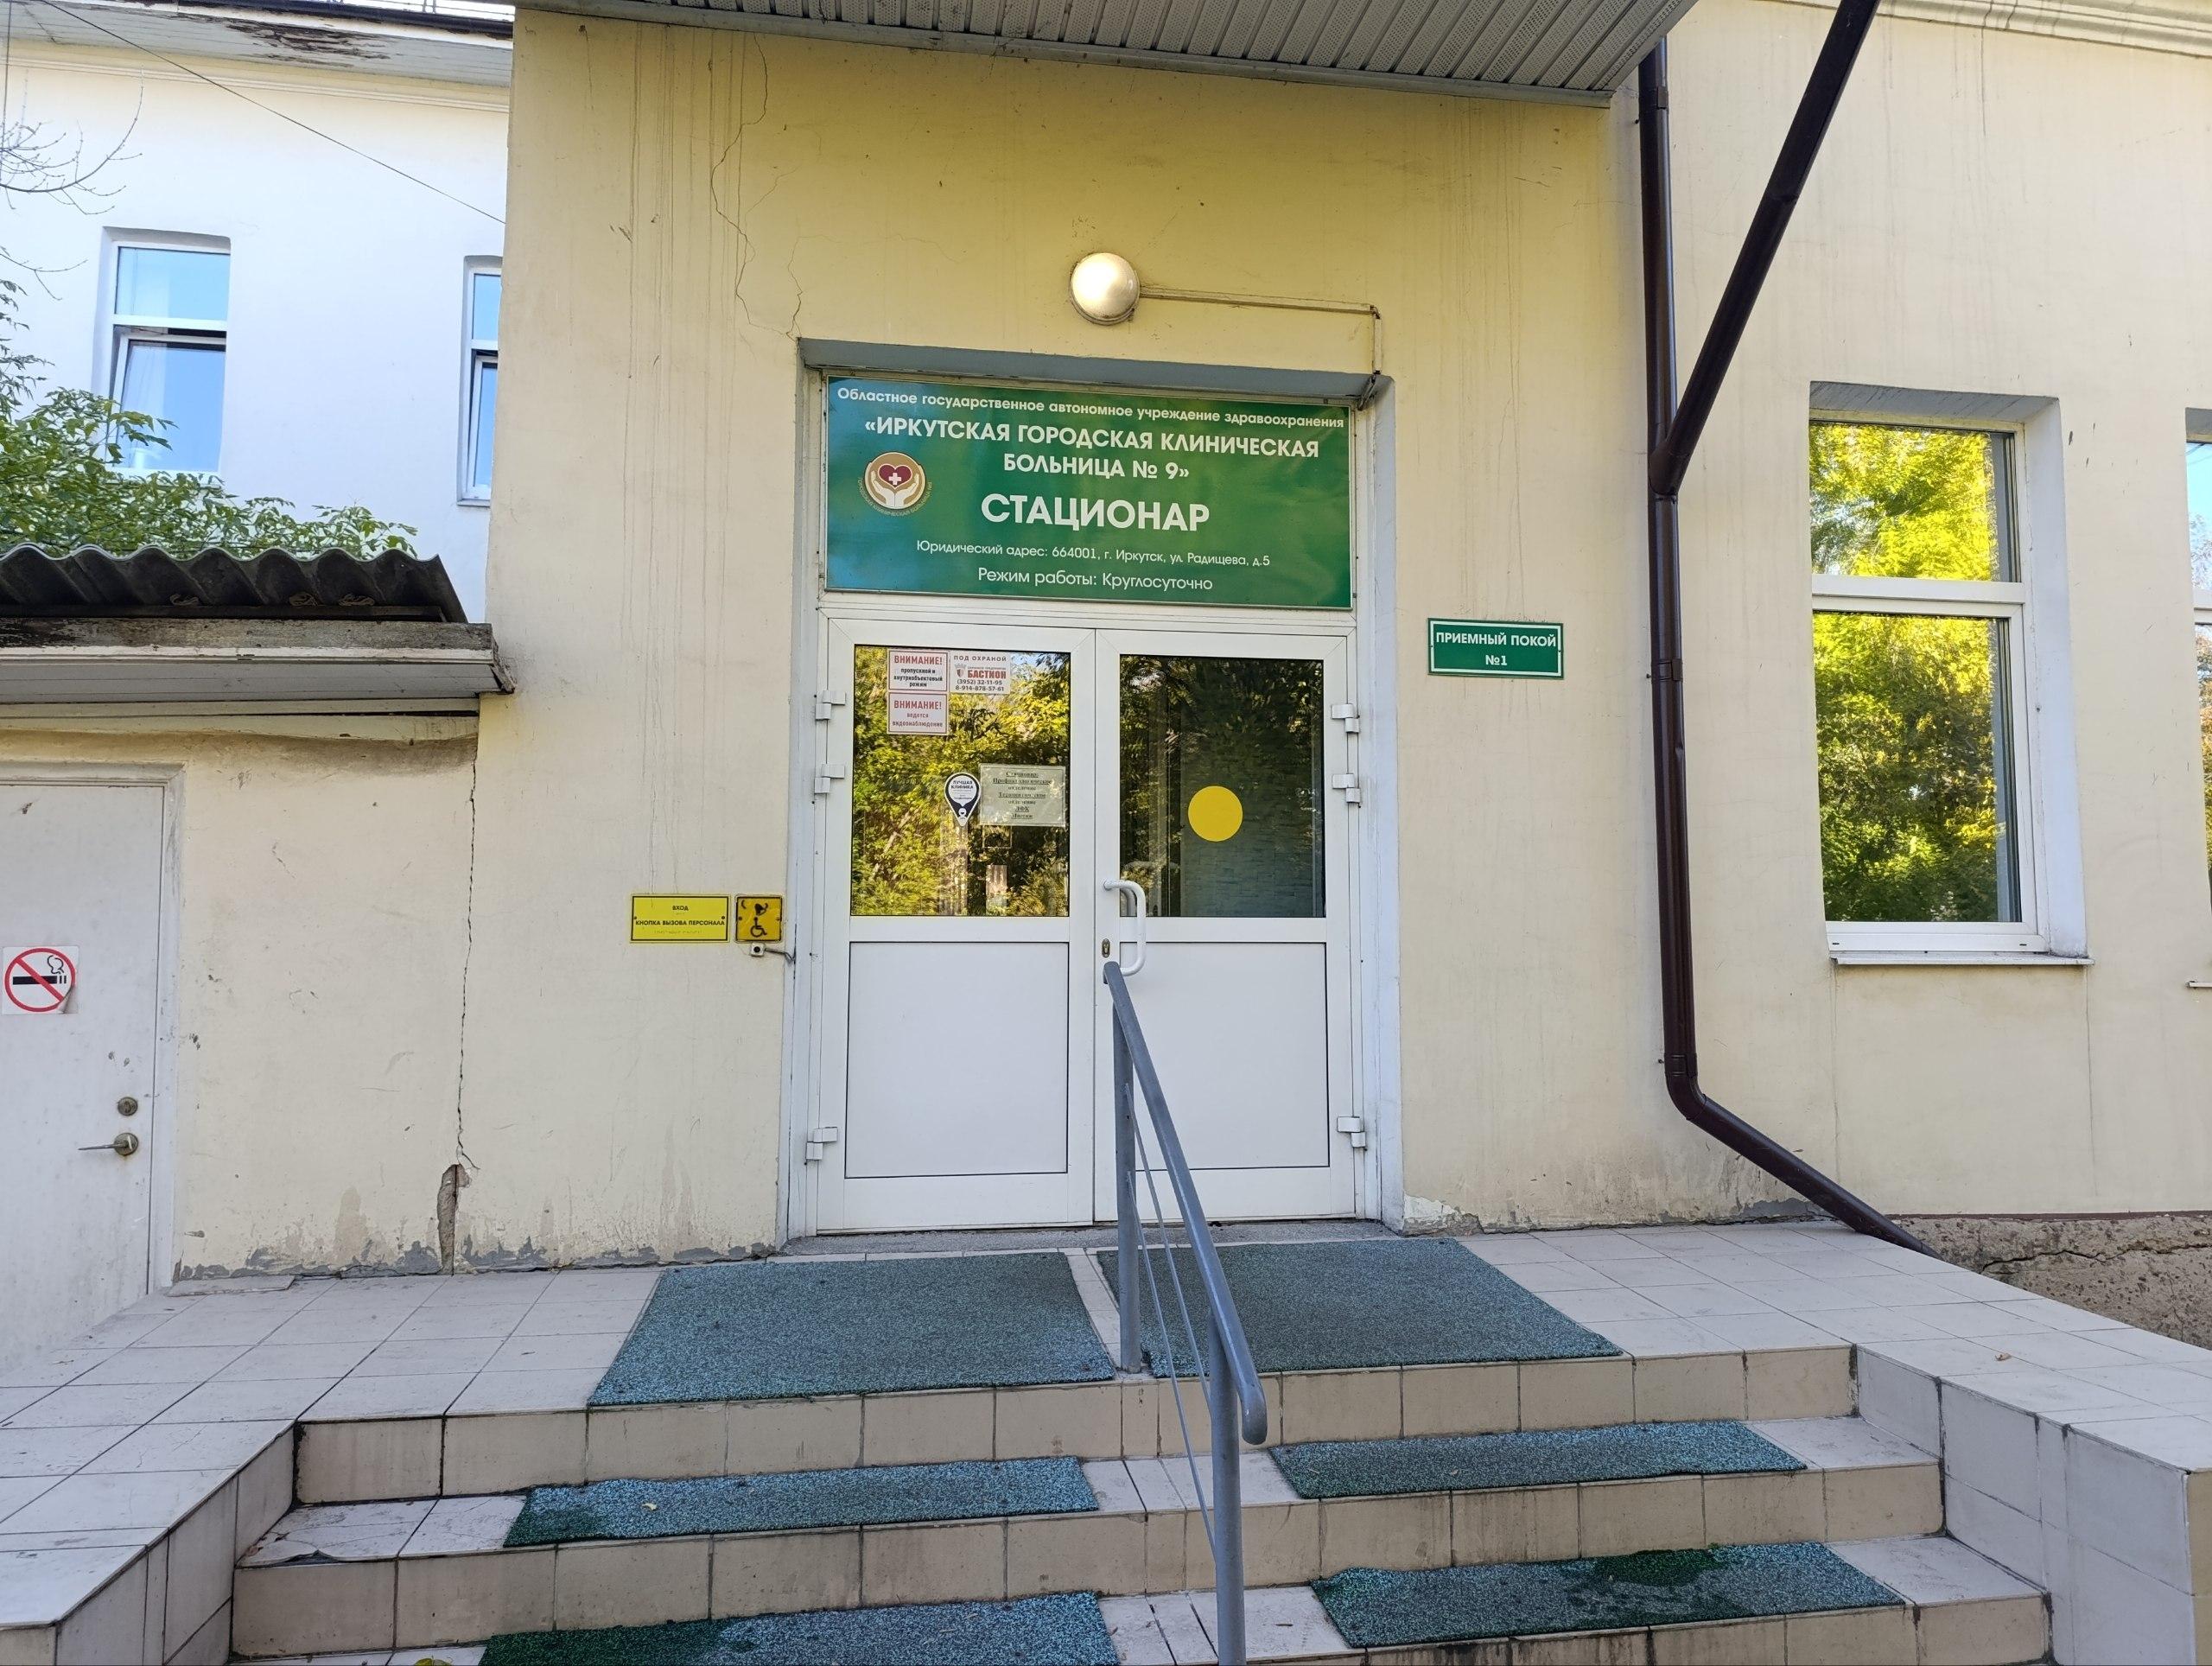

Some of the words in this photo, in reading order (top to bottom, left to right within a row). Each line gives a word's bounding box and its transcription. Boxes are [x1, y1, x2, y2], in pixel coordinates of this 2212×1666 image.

[837, 387, 917, 404] Областное
[922, 394, 1045, 410] государственное
[1049, 403, 1133, 416] автономное
[1137, 409, 1220, 422] учреждение
[1224, 412, 1344, 428] здравоохранения
[865, 416, 1010, 442] «ИРКУТСКАЯ
[1018, 424, 1153, 449] ГОРОДСКАЯ
[1161, 433, 1319, 458] КЛИНИЧЕСКАЯ
[1004, 454, 1125, 479] БОЛЬНИЦА
[981, 493, 1210, 531] СТАЦИОНАР
[917, 540, 1003, 554] Юридический
[1007, 546, 1048, 557] адрес:
[1052, 546, 1101, 560] 664001,
[1104, 551, 1112, 560] г.
[1116, 550, 1166, 564] Иркутск,
[1187, 553, 1249, 566] Радищева,
[1252, 556, 1270, 567] д.5
[978, 568, 1030, 582] Режим
[1035, 569, 1096, 586] работы:
[1103, 572, 1212, 591] Круглосуточно
[1436, 632, 1507, 645] ПРИЕМНЫЙ
[1511, 634, 1556, 646] ПОКОЙ
[894, 655, 943, 664] ВНИМАНИЕ!
[1485, 655, 1507, 665] №1
[968, 669, 1007, 679] БАСТИОН
[893, 701, 942, 709] ВНИМАНИЕ!
